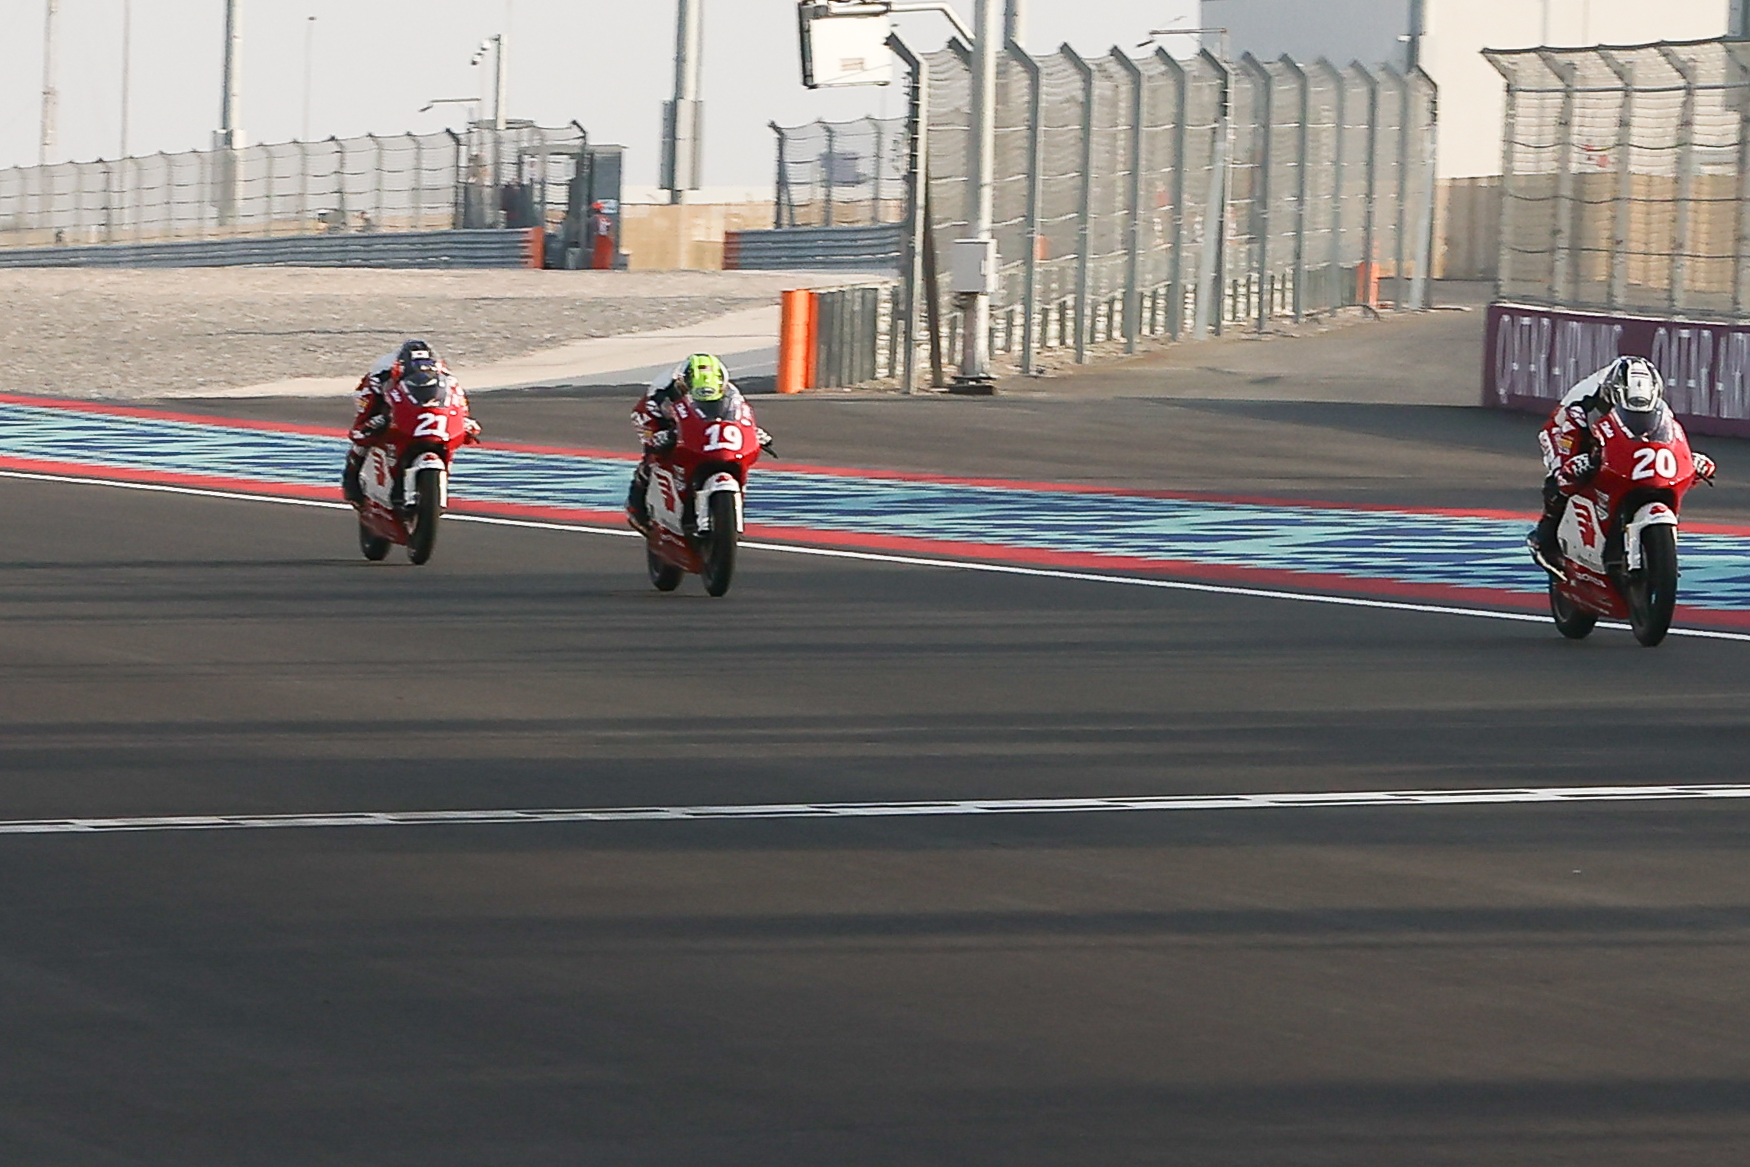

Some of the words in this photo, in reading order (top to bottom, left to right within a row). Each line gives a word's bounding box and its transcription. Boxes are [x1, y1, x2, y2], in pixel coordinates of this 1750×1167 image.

[413, 412, 450, 441] 21
[703, 424, 743, 452] 19
[1631, 447, 1677, 481] 20
